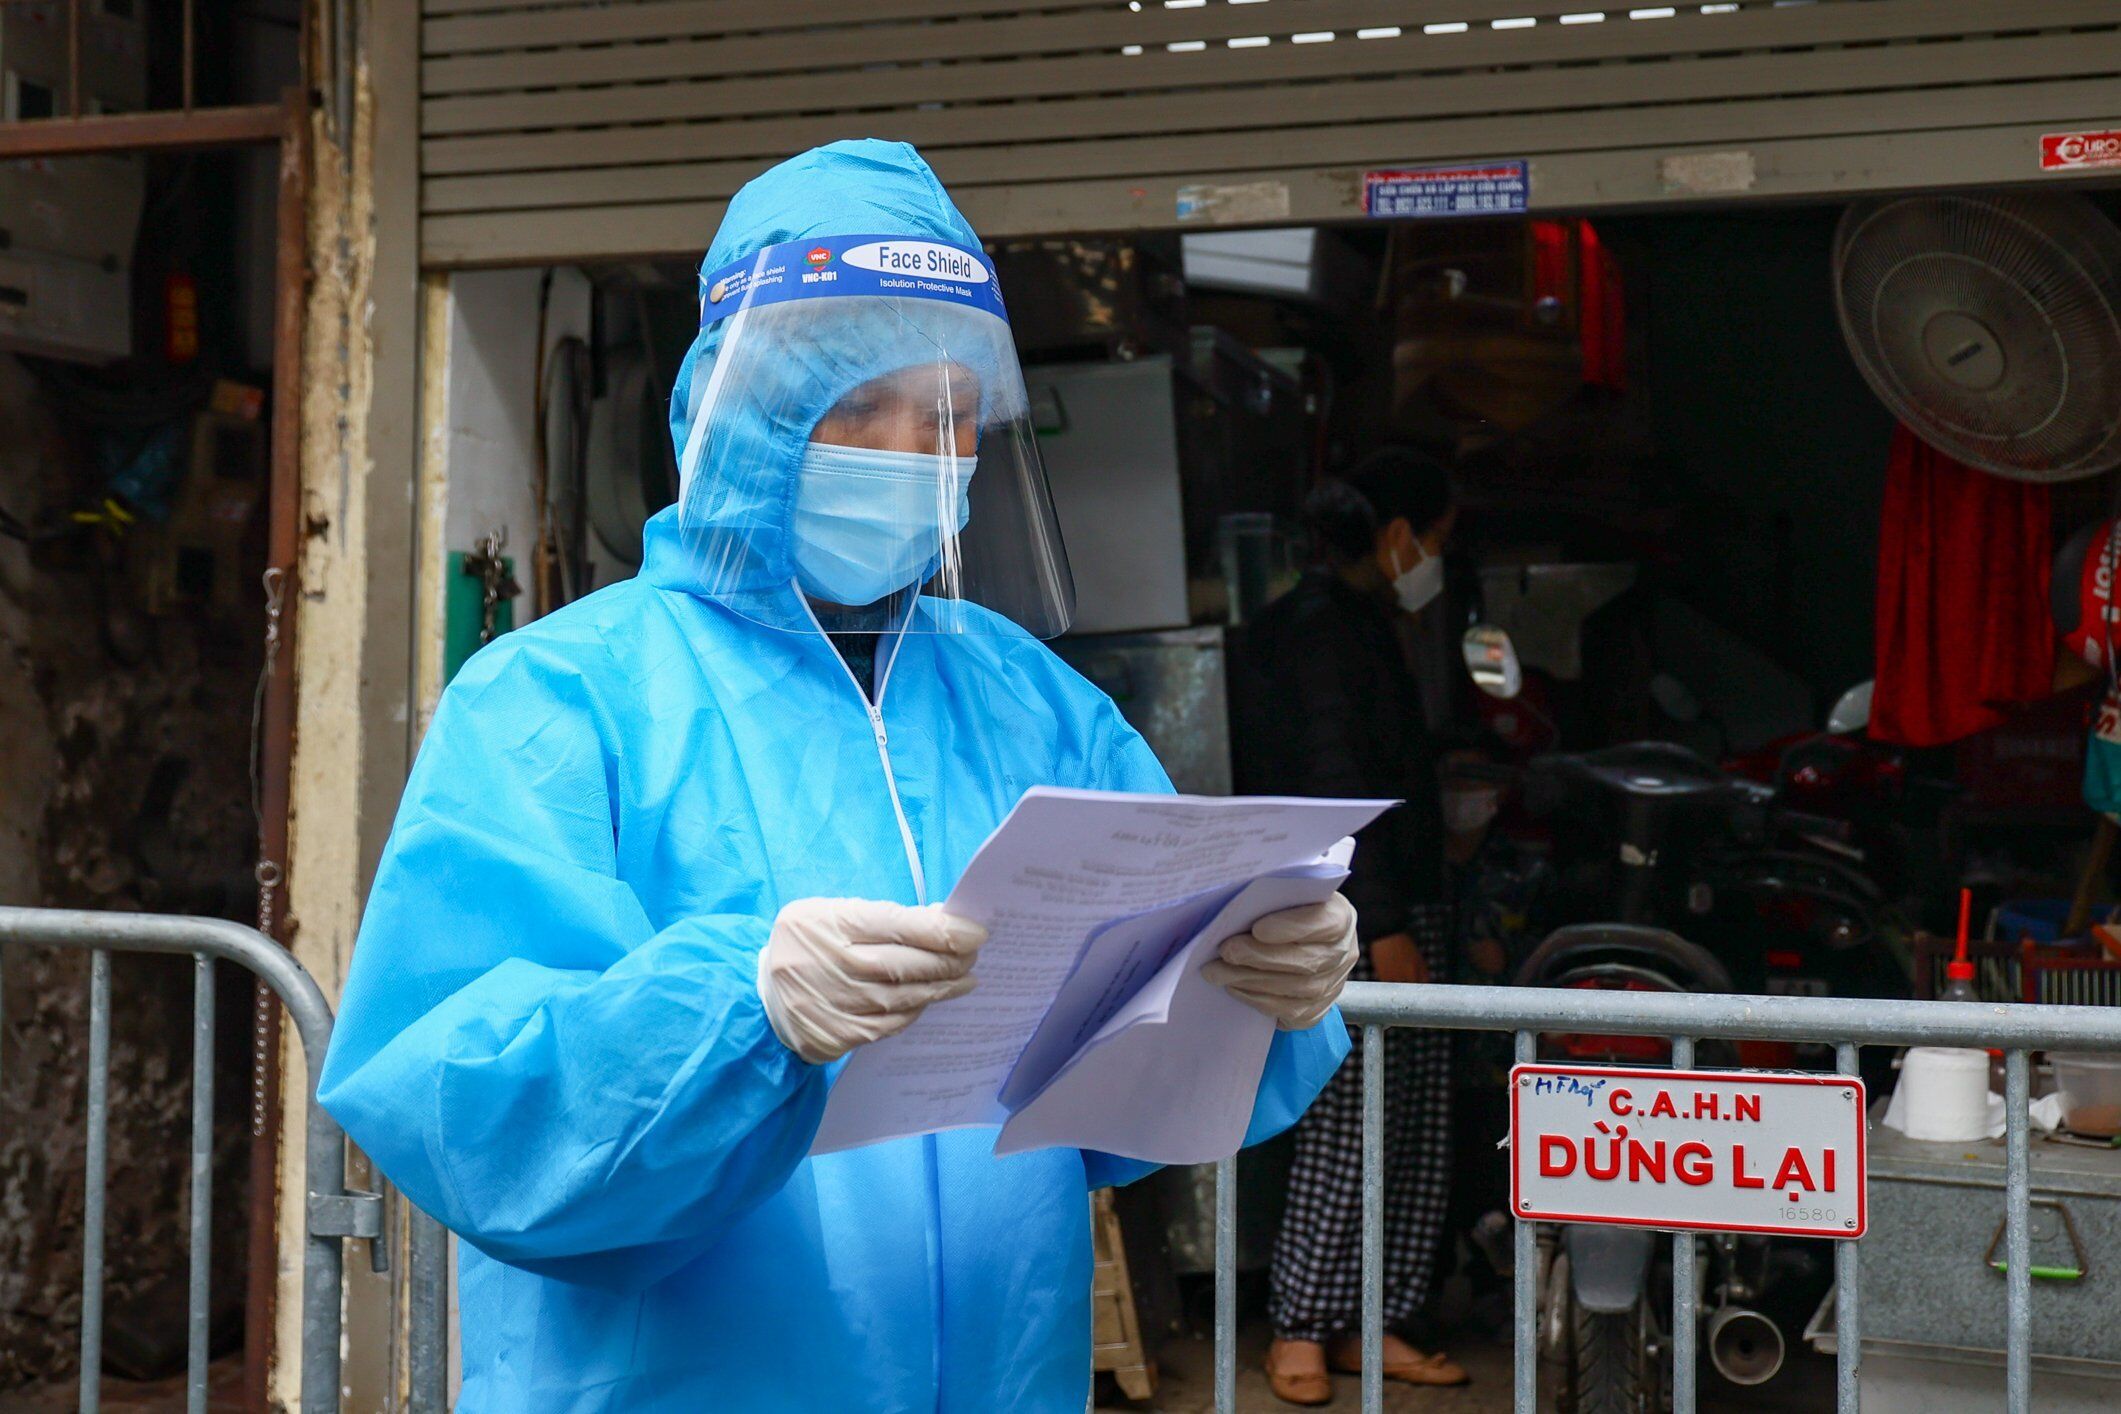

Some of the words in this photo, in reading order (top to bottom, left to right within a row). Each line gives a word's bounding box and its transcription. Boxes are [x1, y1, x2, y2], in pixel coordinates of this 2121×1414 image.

[811, 252, 827, 261] VNC
[879, 246, 921, 270] Face
[927, 249, 971, 279] Shield
[766, 265, 786, 276] shield
[880, 278, 915, 289] Isolution
[917, 280, 954, 294] Protective
[955, 285, 973, 297] Mask
[1608, 1088, 1761, 1121] C.A.H.N
[1539, 1120, 1714, 1186] DỪNG
[1732, 1144, 1836, 1202] LẠI
[1779, 1207, 1837, 1222] 16580
